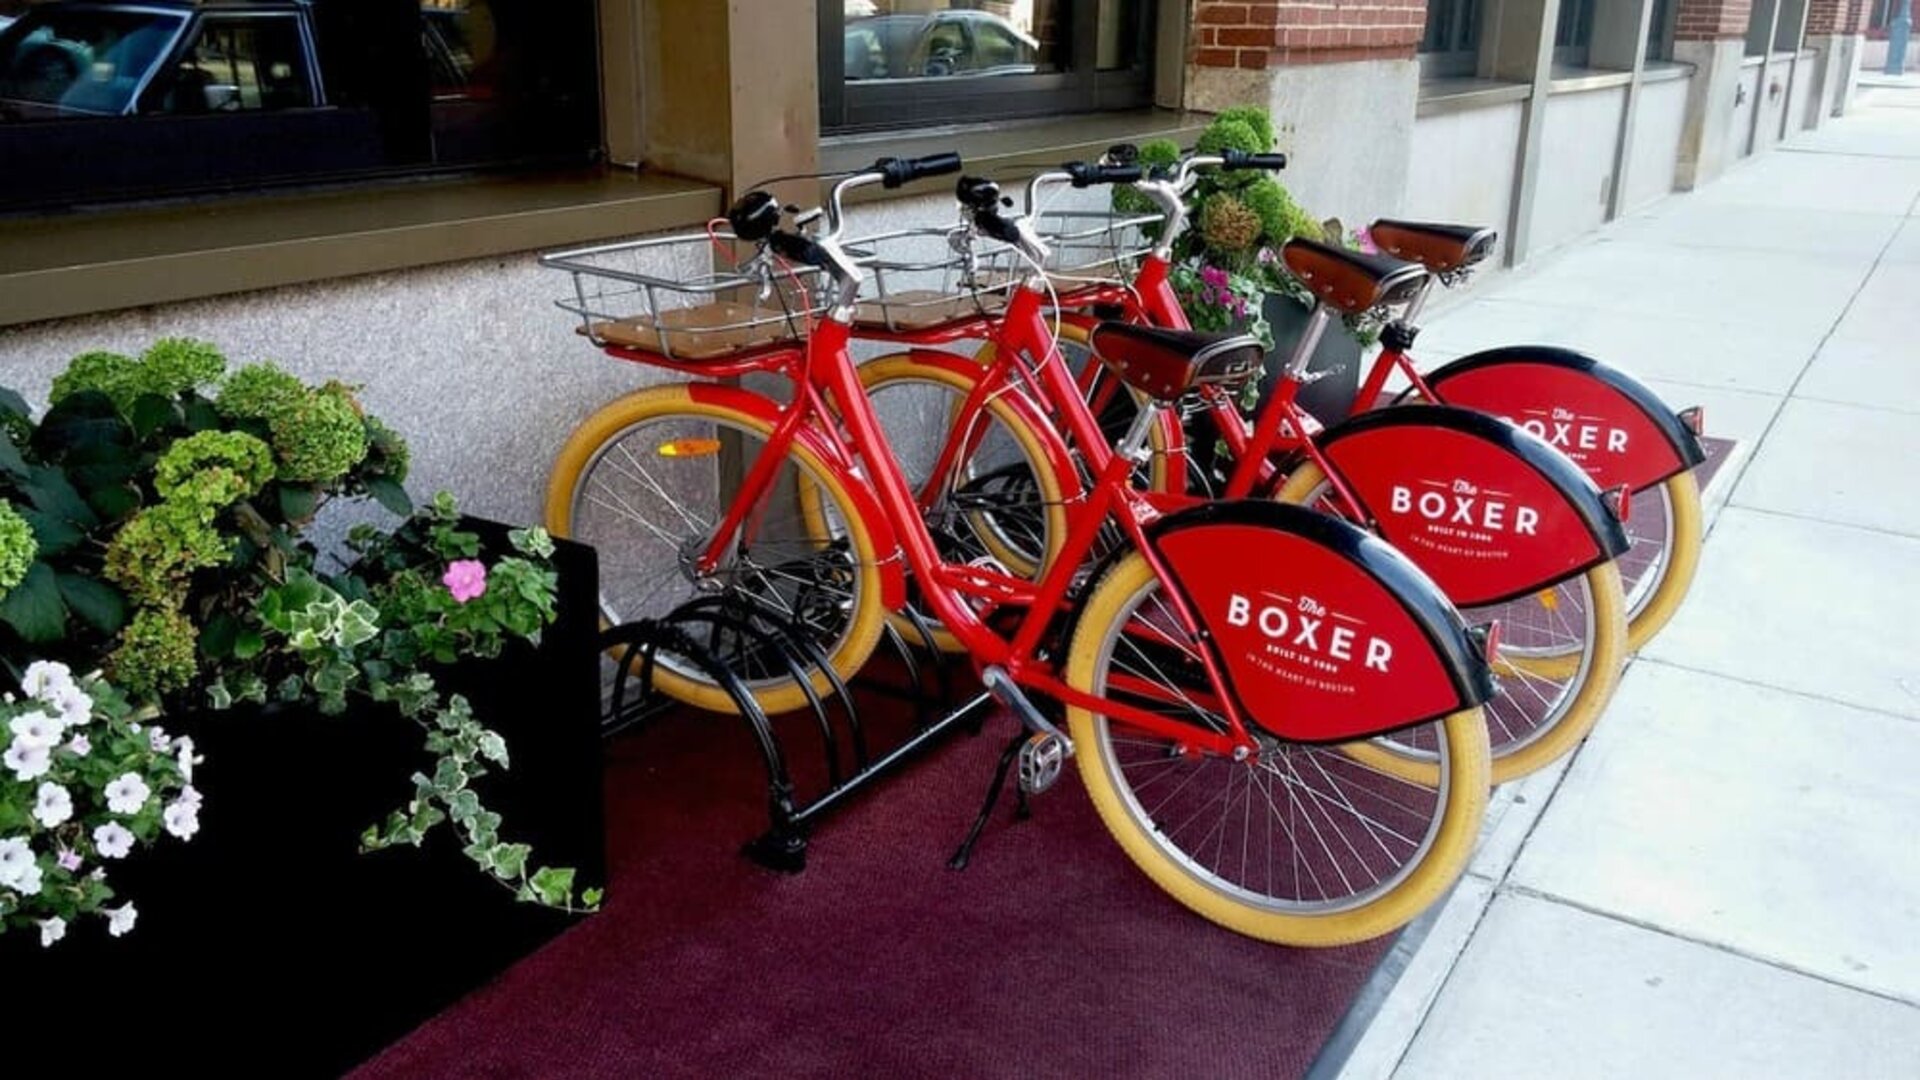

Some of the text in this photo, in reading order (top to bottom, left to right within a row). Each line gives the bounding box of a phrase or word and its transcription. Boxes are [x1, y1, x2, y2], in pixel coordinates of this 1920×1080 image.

[1551, 407, 1574, 420] The
[1452, 479, 1478, 495] The
[1391, 486, 1539, 535] BOXER
[1297, 596, 1327, 617] The
[1227, 594, 1393, 673] BOXER
[1266, 644, 1296, 660] BUILT
[1298, 653, 1311, 664] IN
